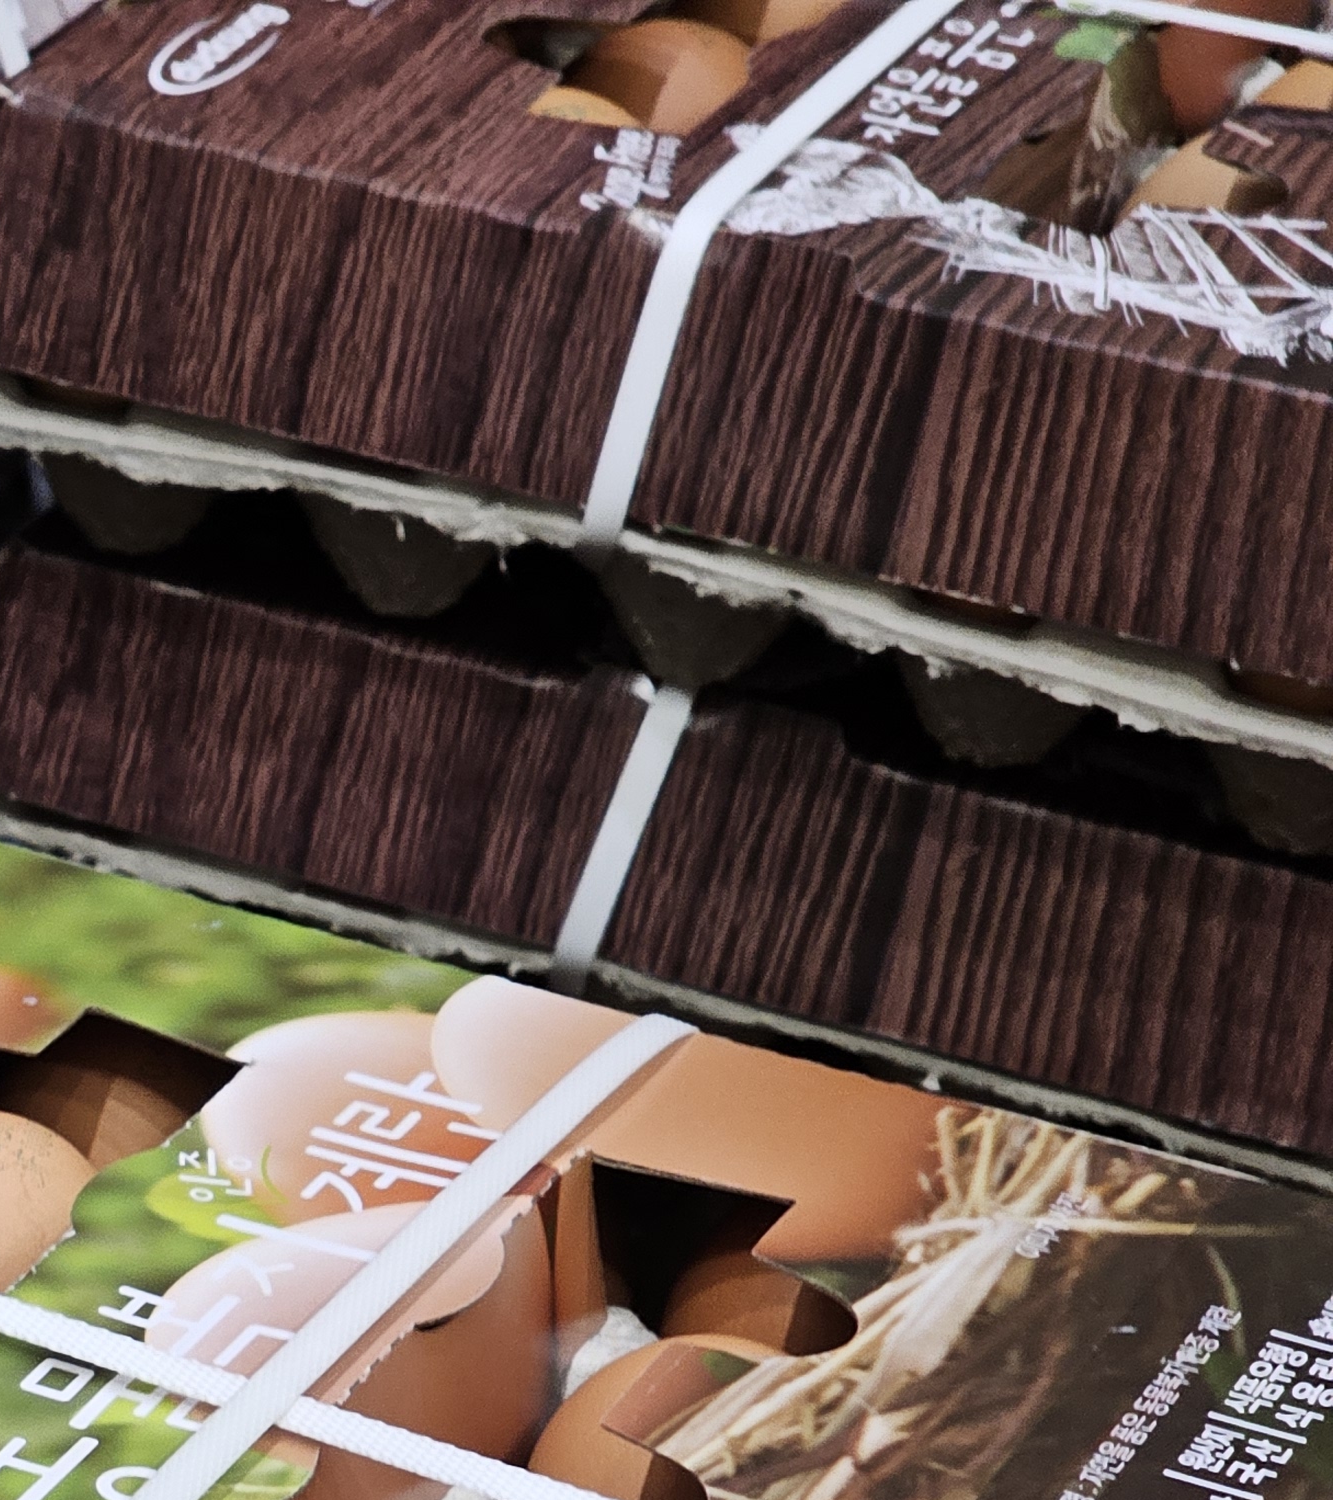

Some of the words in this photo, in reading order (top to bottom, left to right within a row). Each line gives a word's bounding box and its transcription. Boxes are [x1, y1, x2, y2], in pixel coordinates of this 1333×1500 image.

[917, 17, 1036, 71] 품은
[861, 67, 979, 144] 자연을
[175, 1146, 254, 1204] 인증
[1223, 1340, 1310, 1415] 식품유형
[1226, 1436, 1293, 1486] 국산
